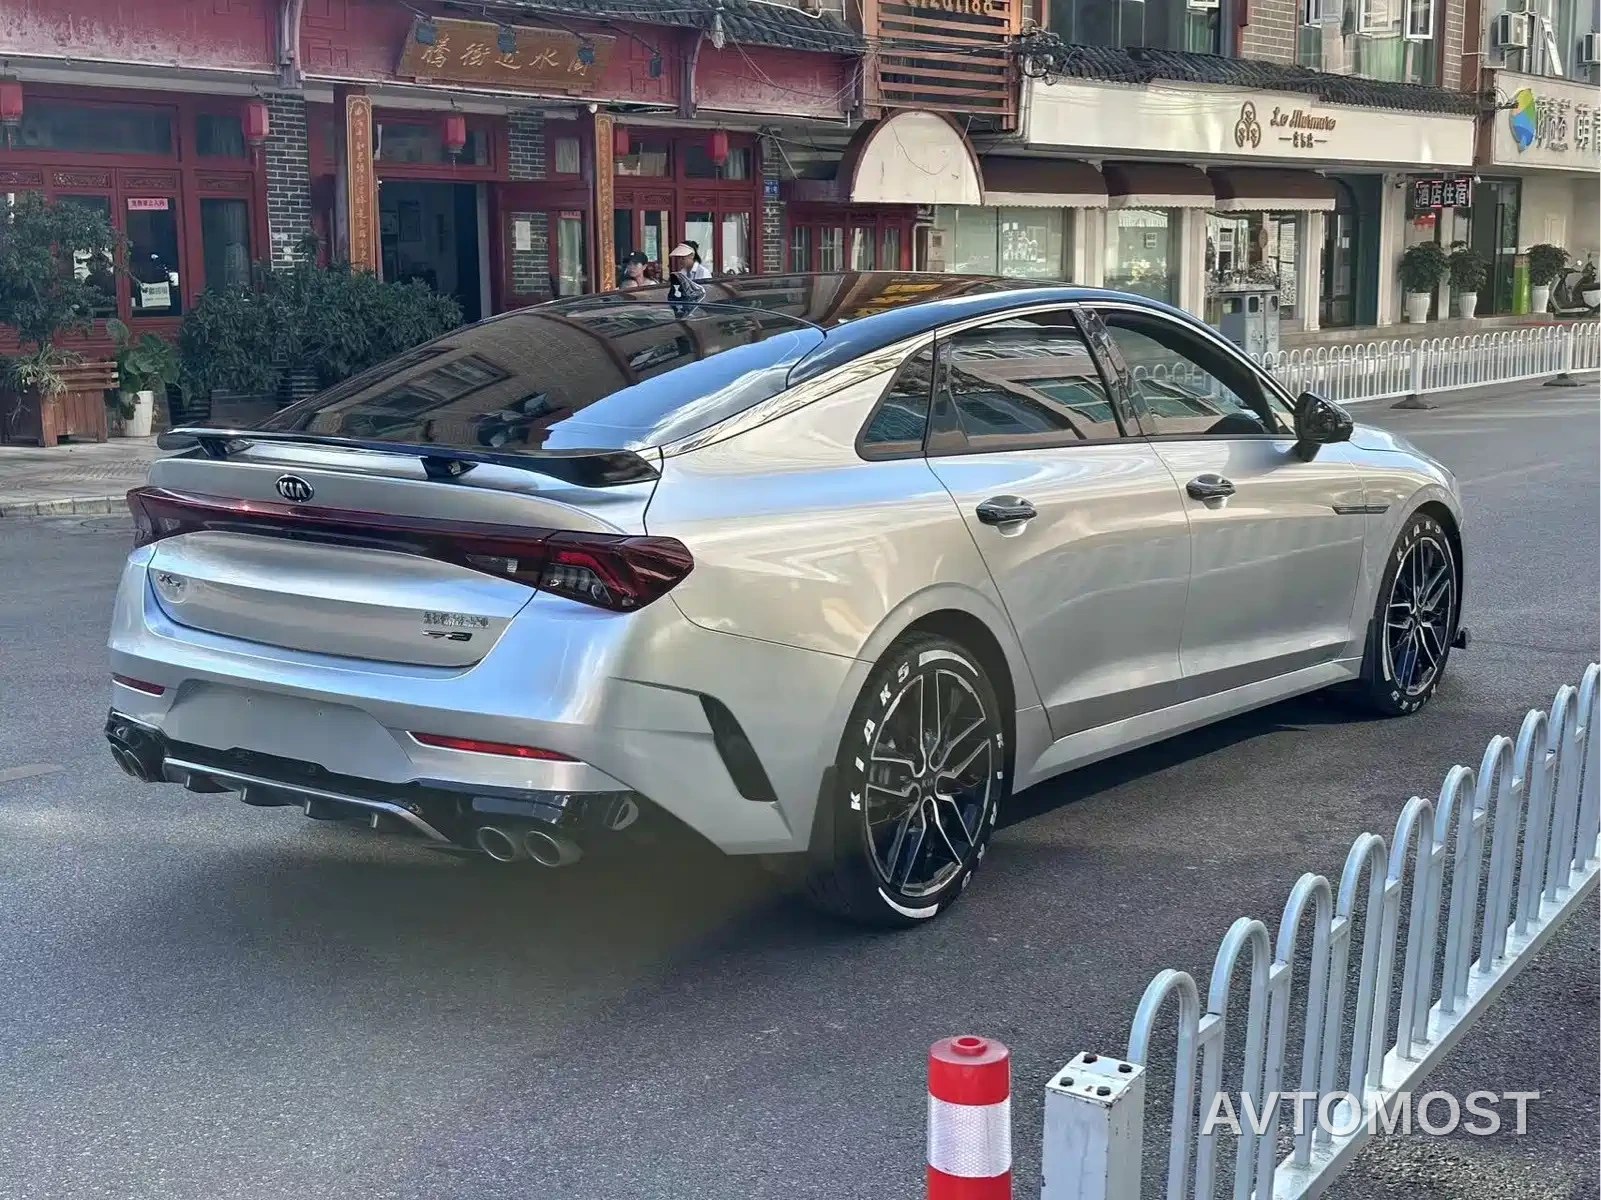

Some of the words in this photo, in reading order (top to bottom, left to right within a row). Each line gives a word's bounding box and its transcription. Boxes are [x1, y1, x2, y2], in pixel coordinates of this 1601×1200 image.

[1418, 183, 1467, 206] 酒店住宿
[277, 478, 309, 499] KIA
